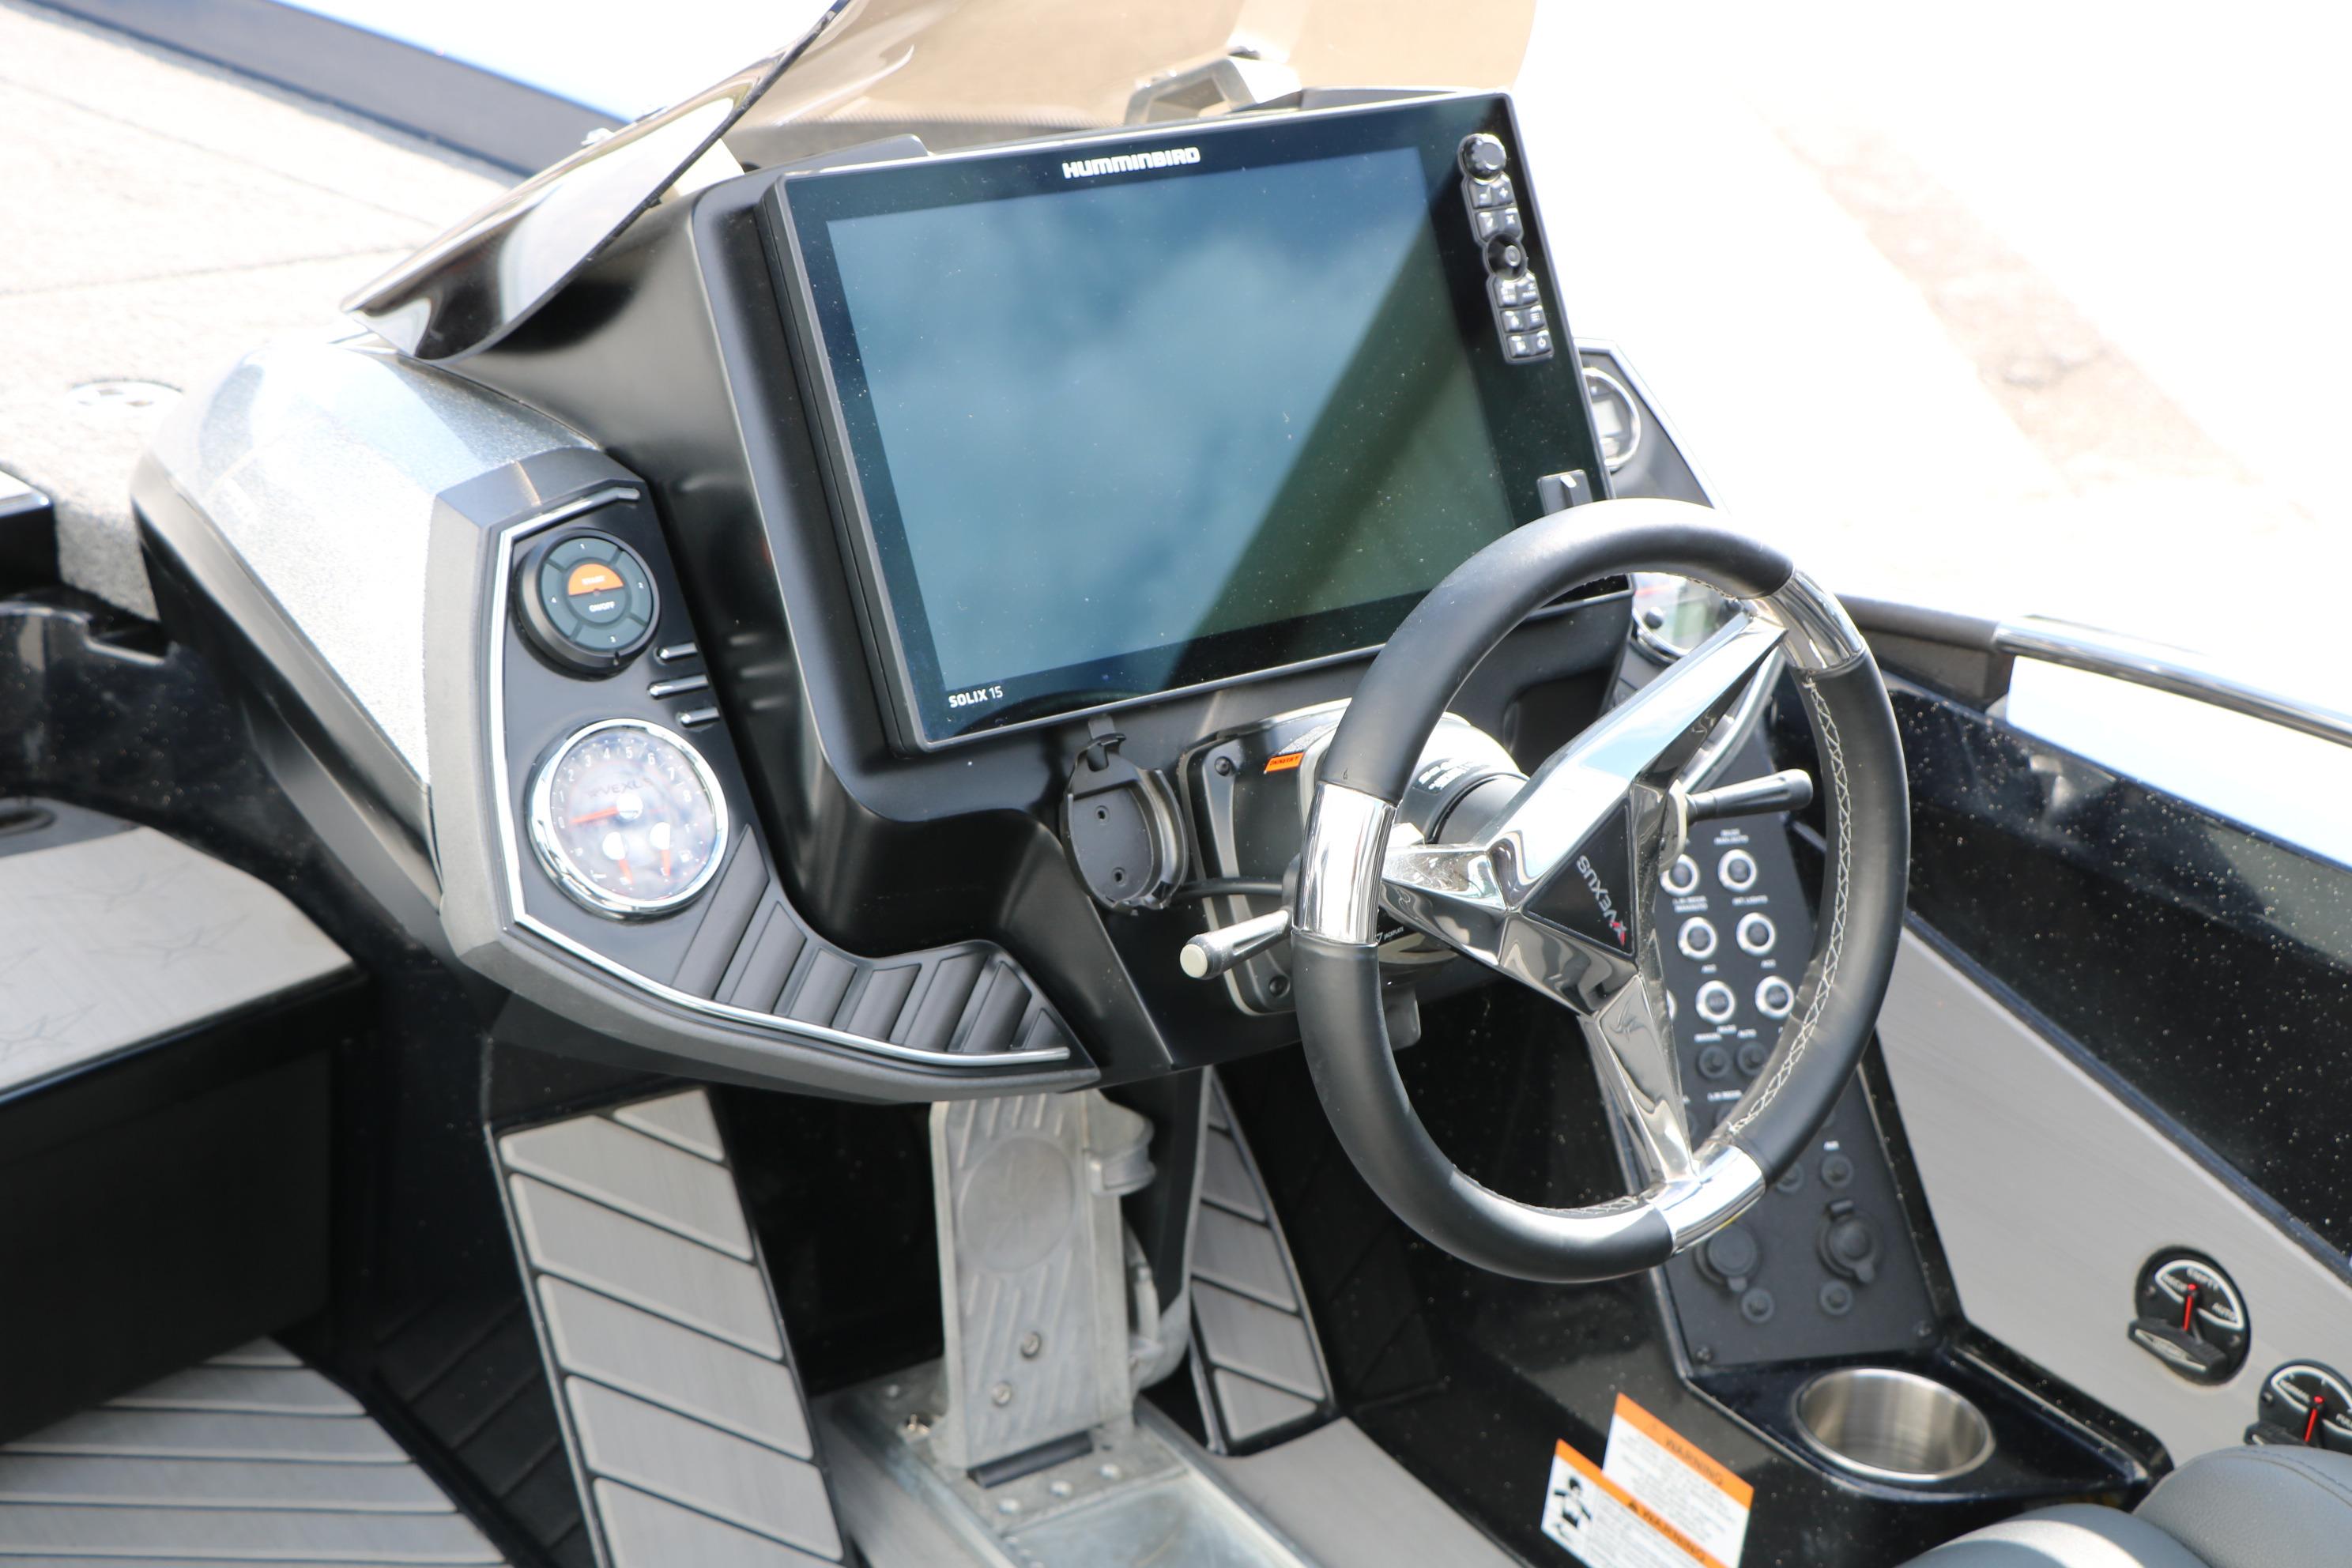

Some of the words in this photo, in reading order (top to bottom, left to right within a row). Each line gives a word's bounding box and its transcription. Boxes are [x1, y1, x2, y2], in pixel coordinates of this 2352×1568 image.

[1062, 147, 1200, 179] HUMMINBIRD
[948, 688, 988, 708] SOLIX
[989, 685, 1003, 699] 15
[603, 748, 611, 760] 4
[625, 746, 633, 759] 5
[647, 752, 656, 765] 6
[584, 755, 592, 767] 3
[567, 769, 575, 782] 2
[667, 766, 675, 780] 7
[683, 790, 692, 802] 8
[1576, 854, 1618, 923] VEXUS
